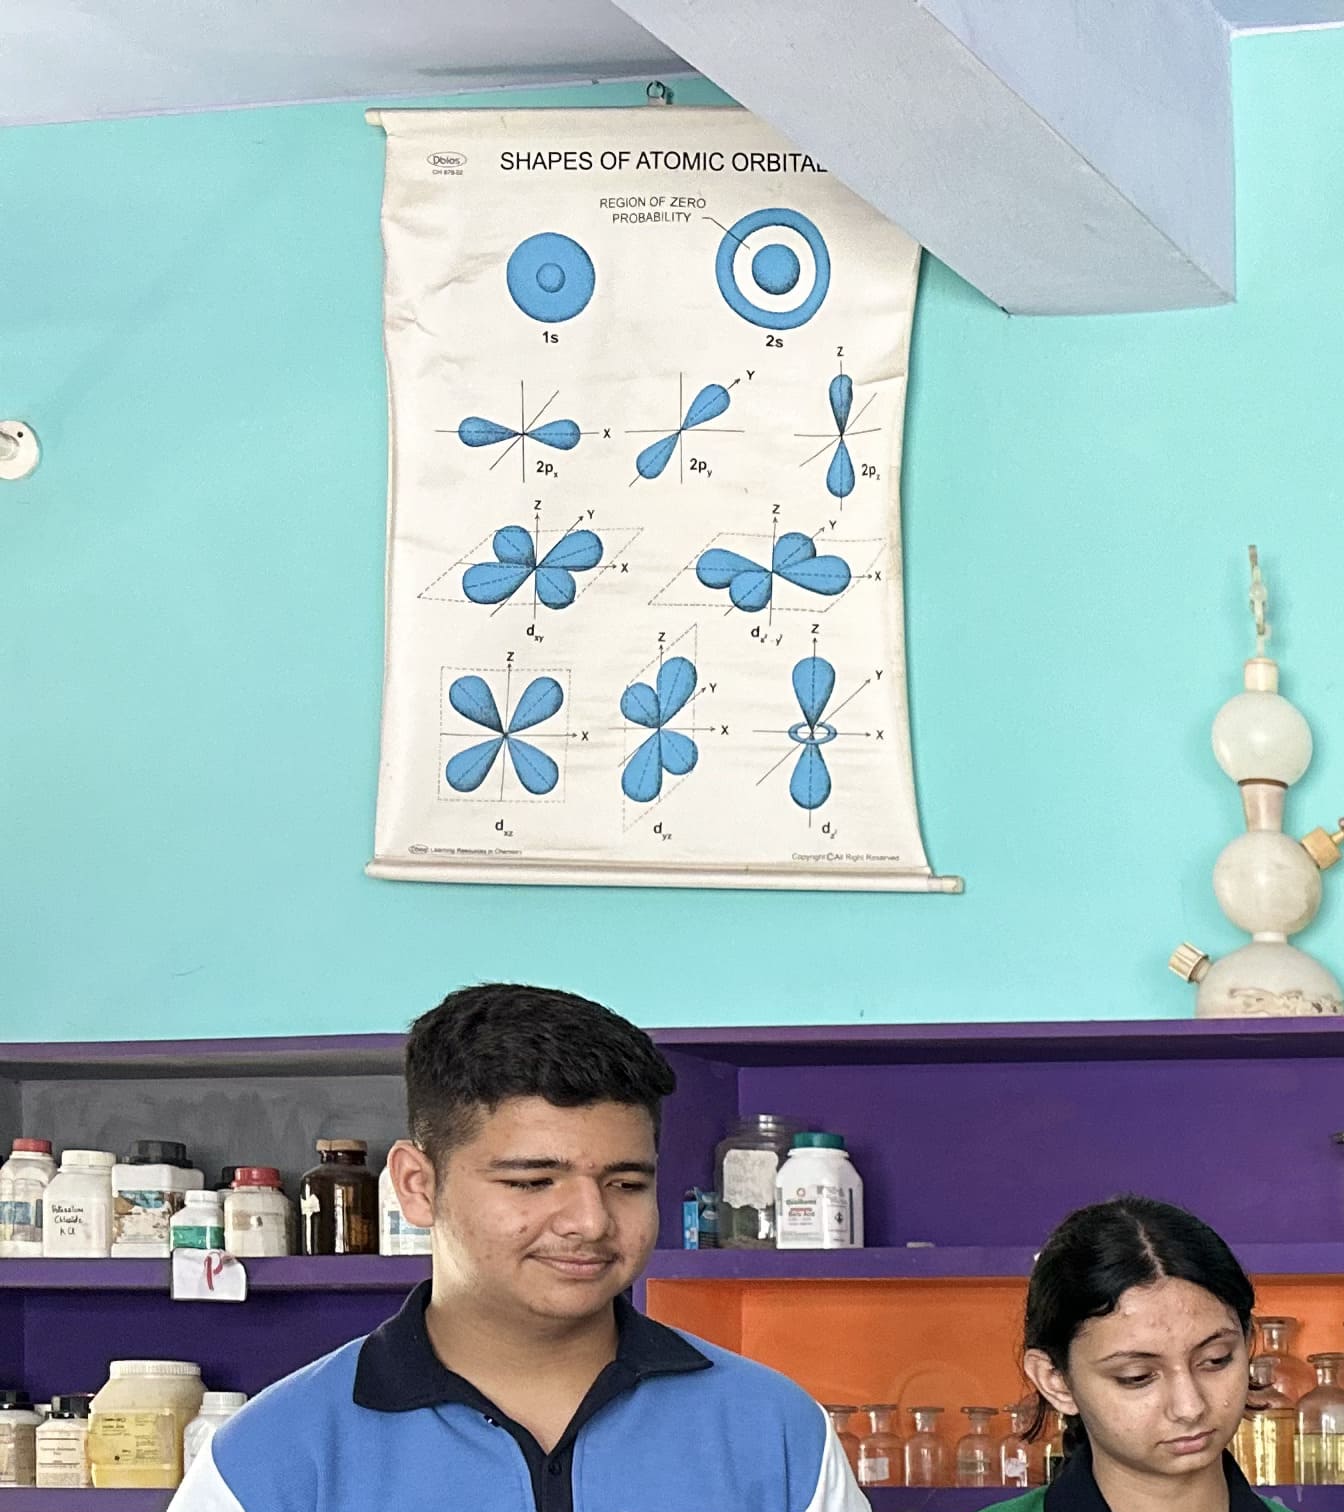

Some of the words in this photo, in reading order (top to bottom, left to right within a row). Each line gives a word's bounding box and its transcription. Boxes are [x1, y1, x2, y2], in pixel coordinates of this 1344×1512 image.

[501, 152, 592, 170] SHAPES
[600, 152, 631, 170] OF
[635, 152, 725, 171] ATOMIC
[599, 197, 646, 208] REGION
[649, 197, 666, 208] OF
[670, 196, 706, 208] ZERO
[612, 212, 692, 224] PROBABILITY
[542, 331, 559, 344] 1s
[765, 335, 784, 349] 2s
